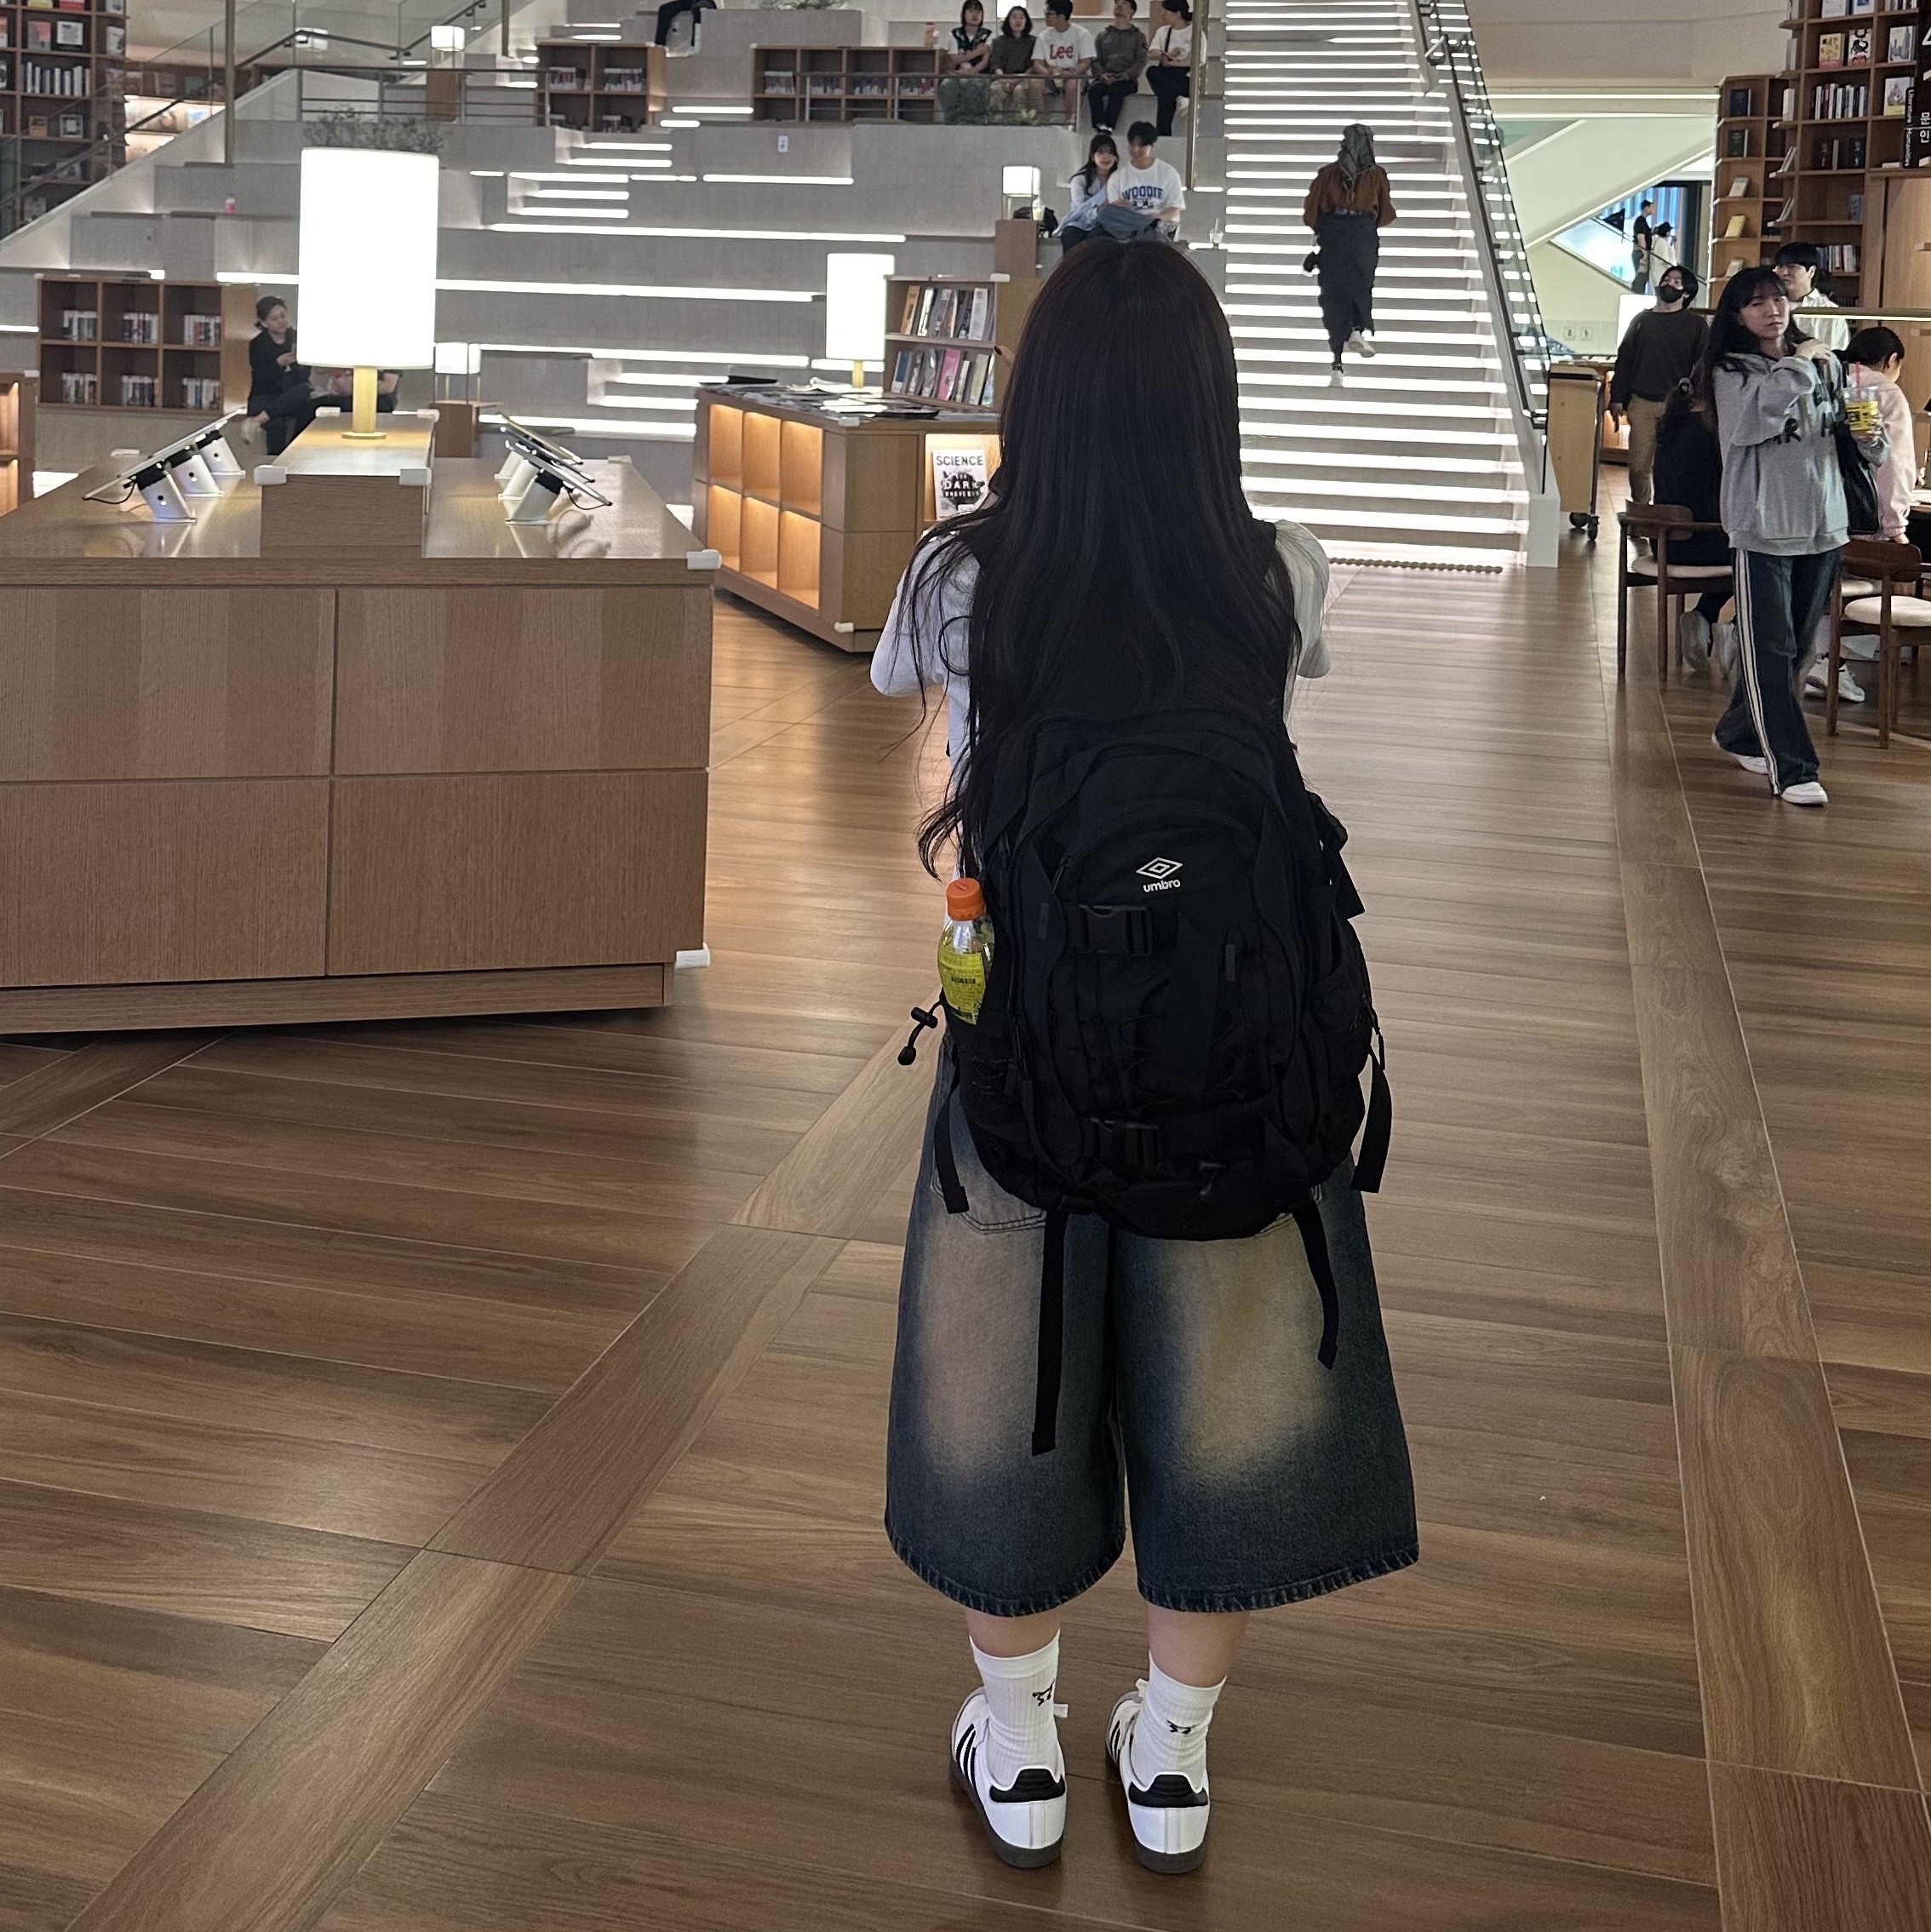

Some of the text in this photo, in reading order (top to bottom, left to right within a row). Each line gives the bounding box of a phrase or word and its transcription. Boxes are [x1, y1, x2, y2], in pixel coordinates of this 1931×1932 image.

[1049, 43, 1074, 60] Lee
[936, 455, 983, 467] SCIENCE
[943, 479, 979, 490] DARK
[1143, 879, 1181, 893] umbro
